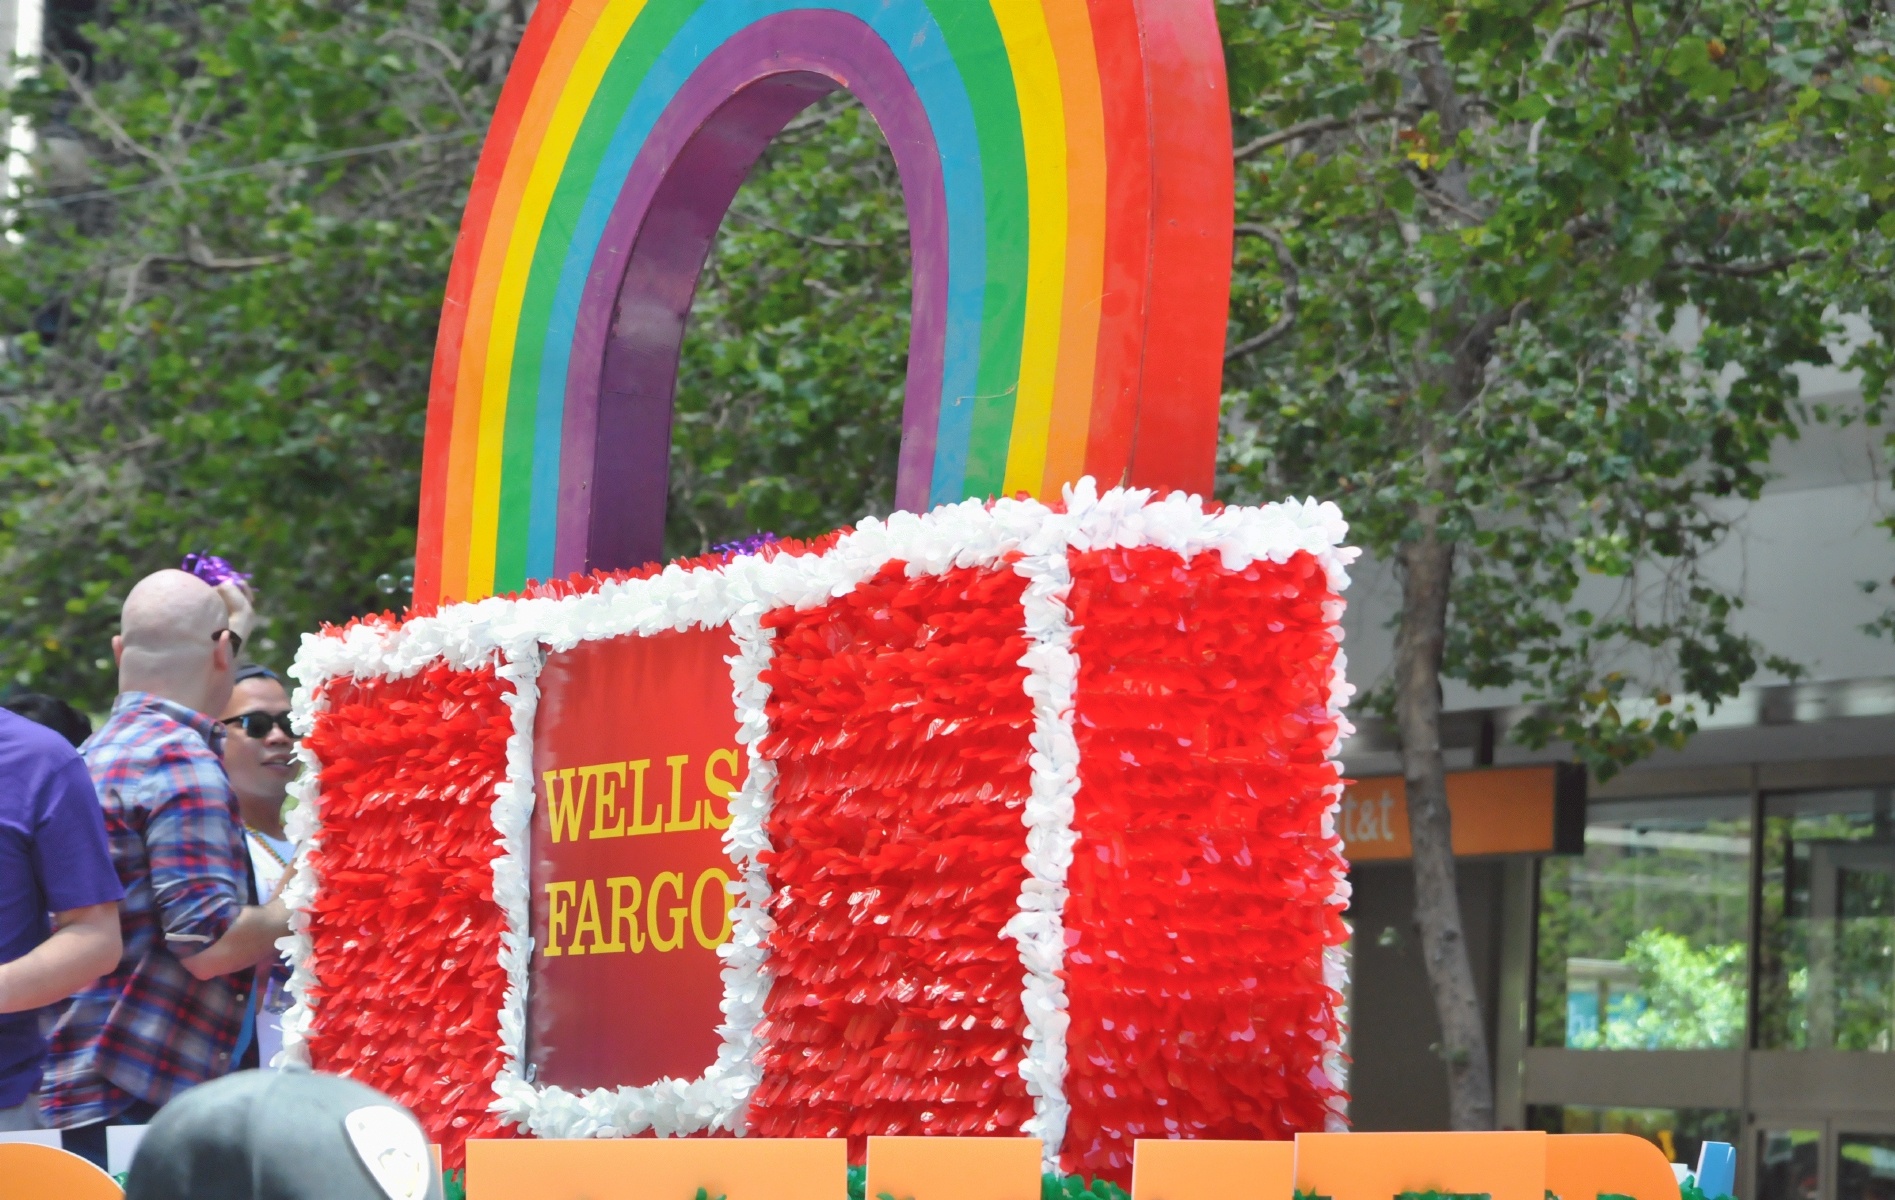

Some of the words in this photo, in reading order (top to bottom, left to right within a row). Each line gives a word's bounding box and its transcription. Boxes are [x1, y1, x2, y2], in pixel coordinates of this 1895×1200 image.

[542, 748, 739, 843] WELLS
[1333, 789, 1395, 842] t&t
[543, 867, 736, 957] FARGO
